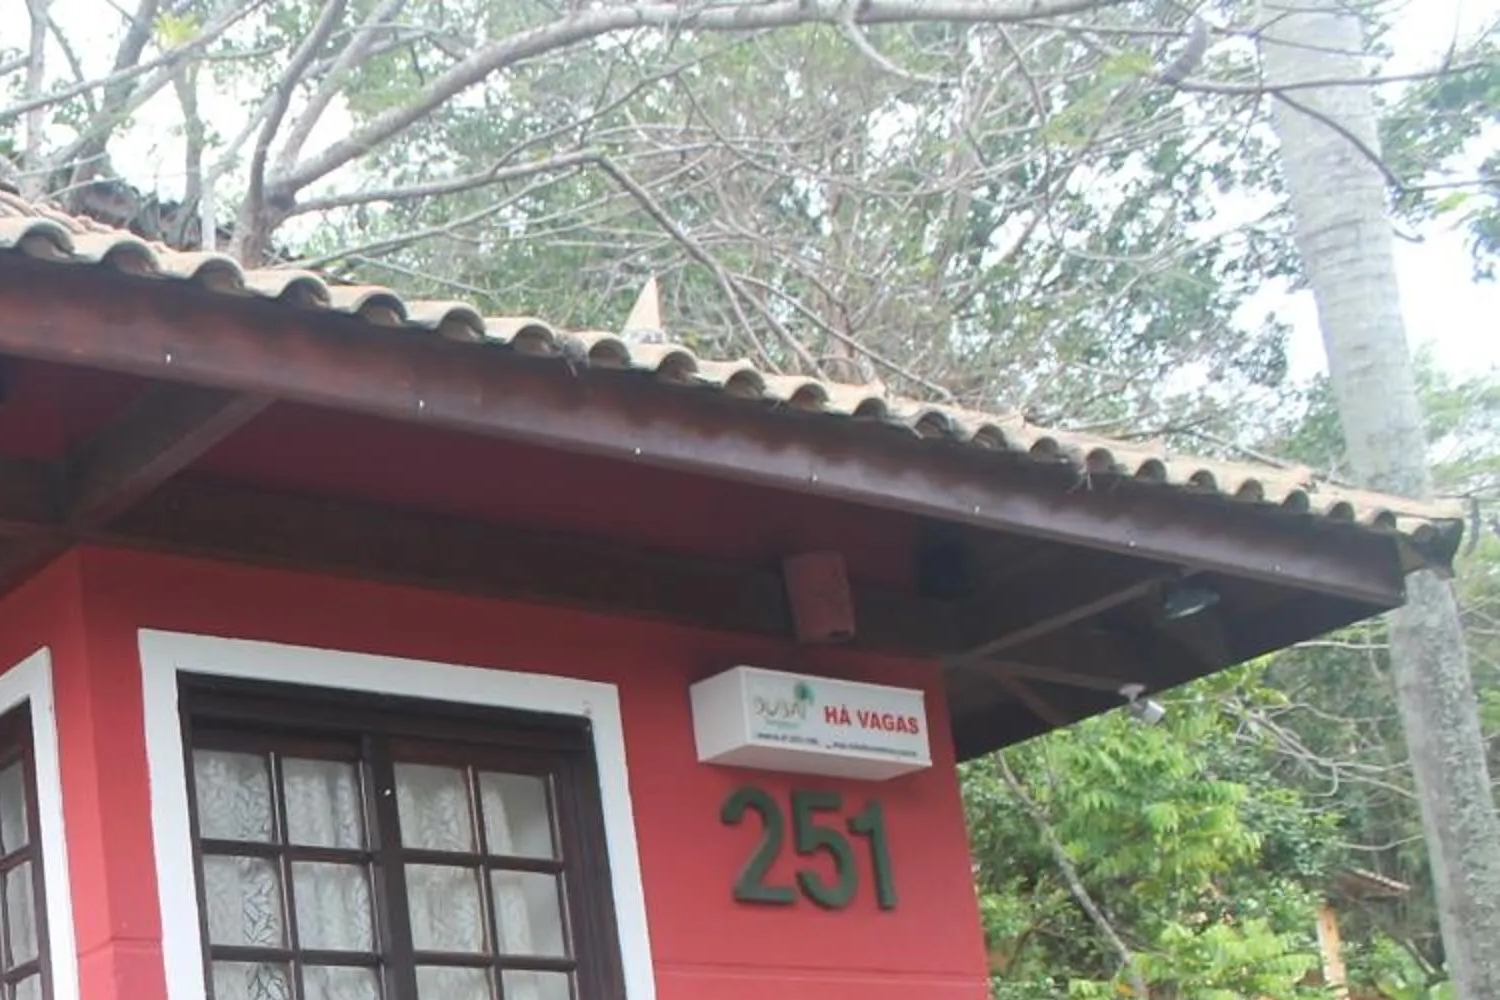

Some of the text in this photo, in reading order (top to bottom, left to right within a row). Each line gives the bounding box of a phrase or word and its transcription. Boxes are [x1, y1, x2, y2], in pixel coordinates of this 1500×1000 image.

[824, 704, 852, 726] HÁ
[857, 709, 919, 735] VAGAS
[720, 786, 897, 910] 251
